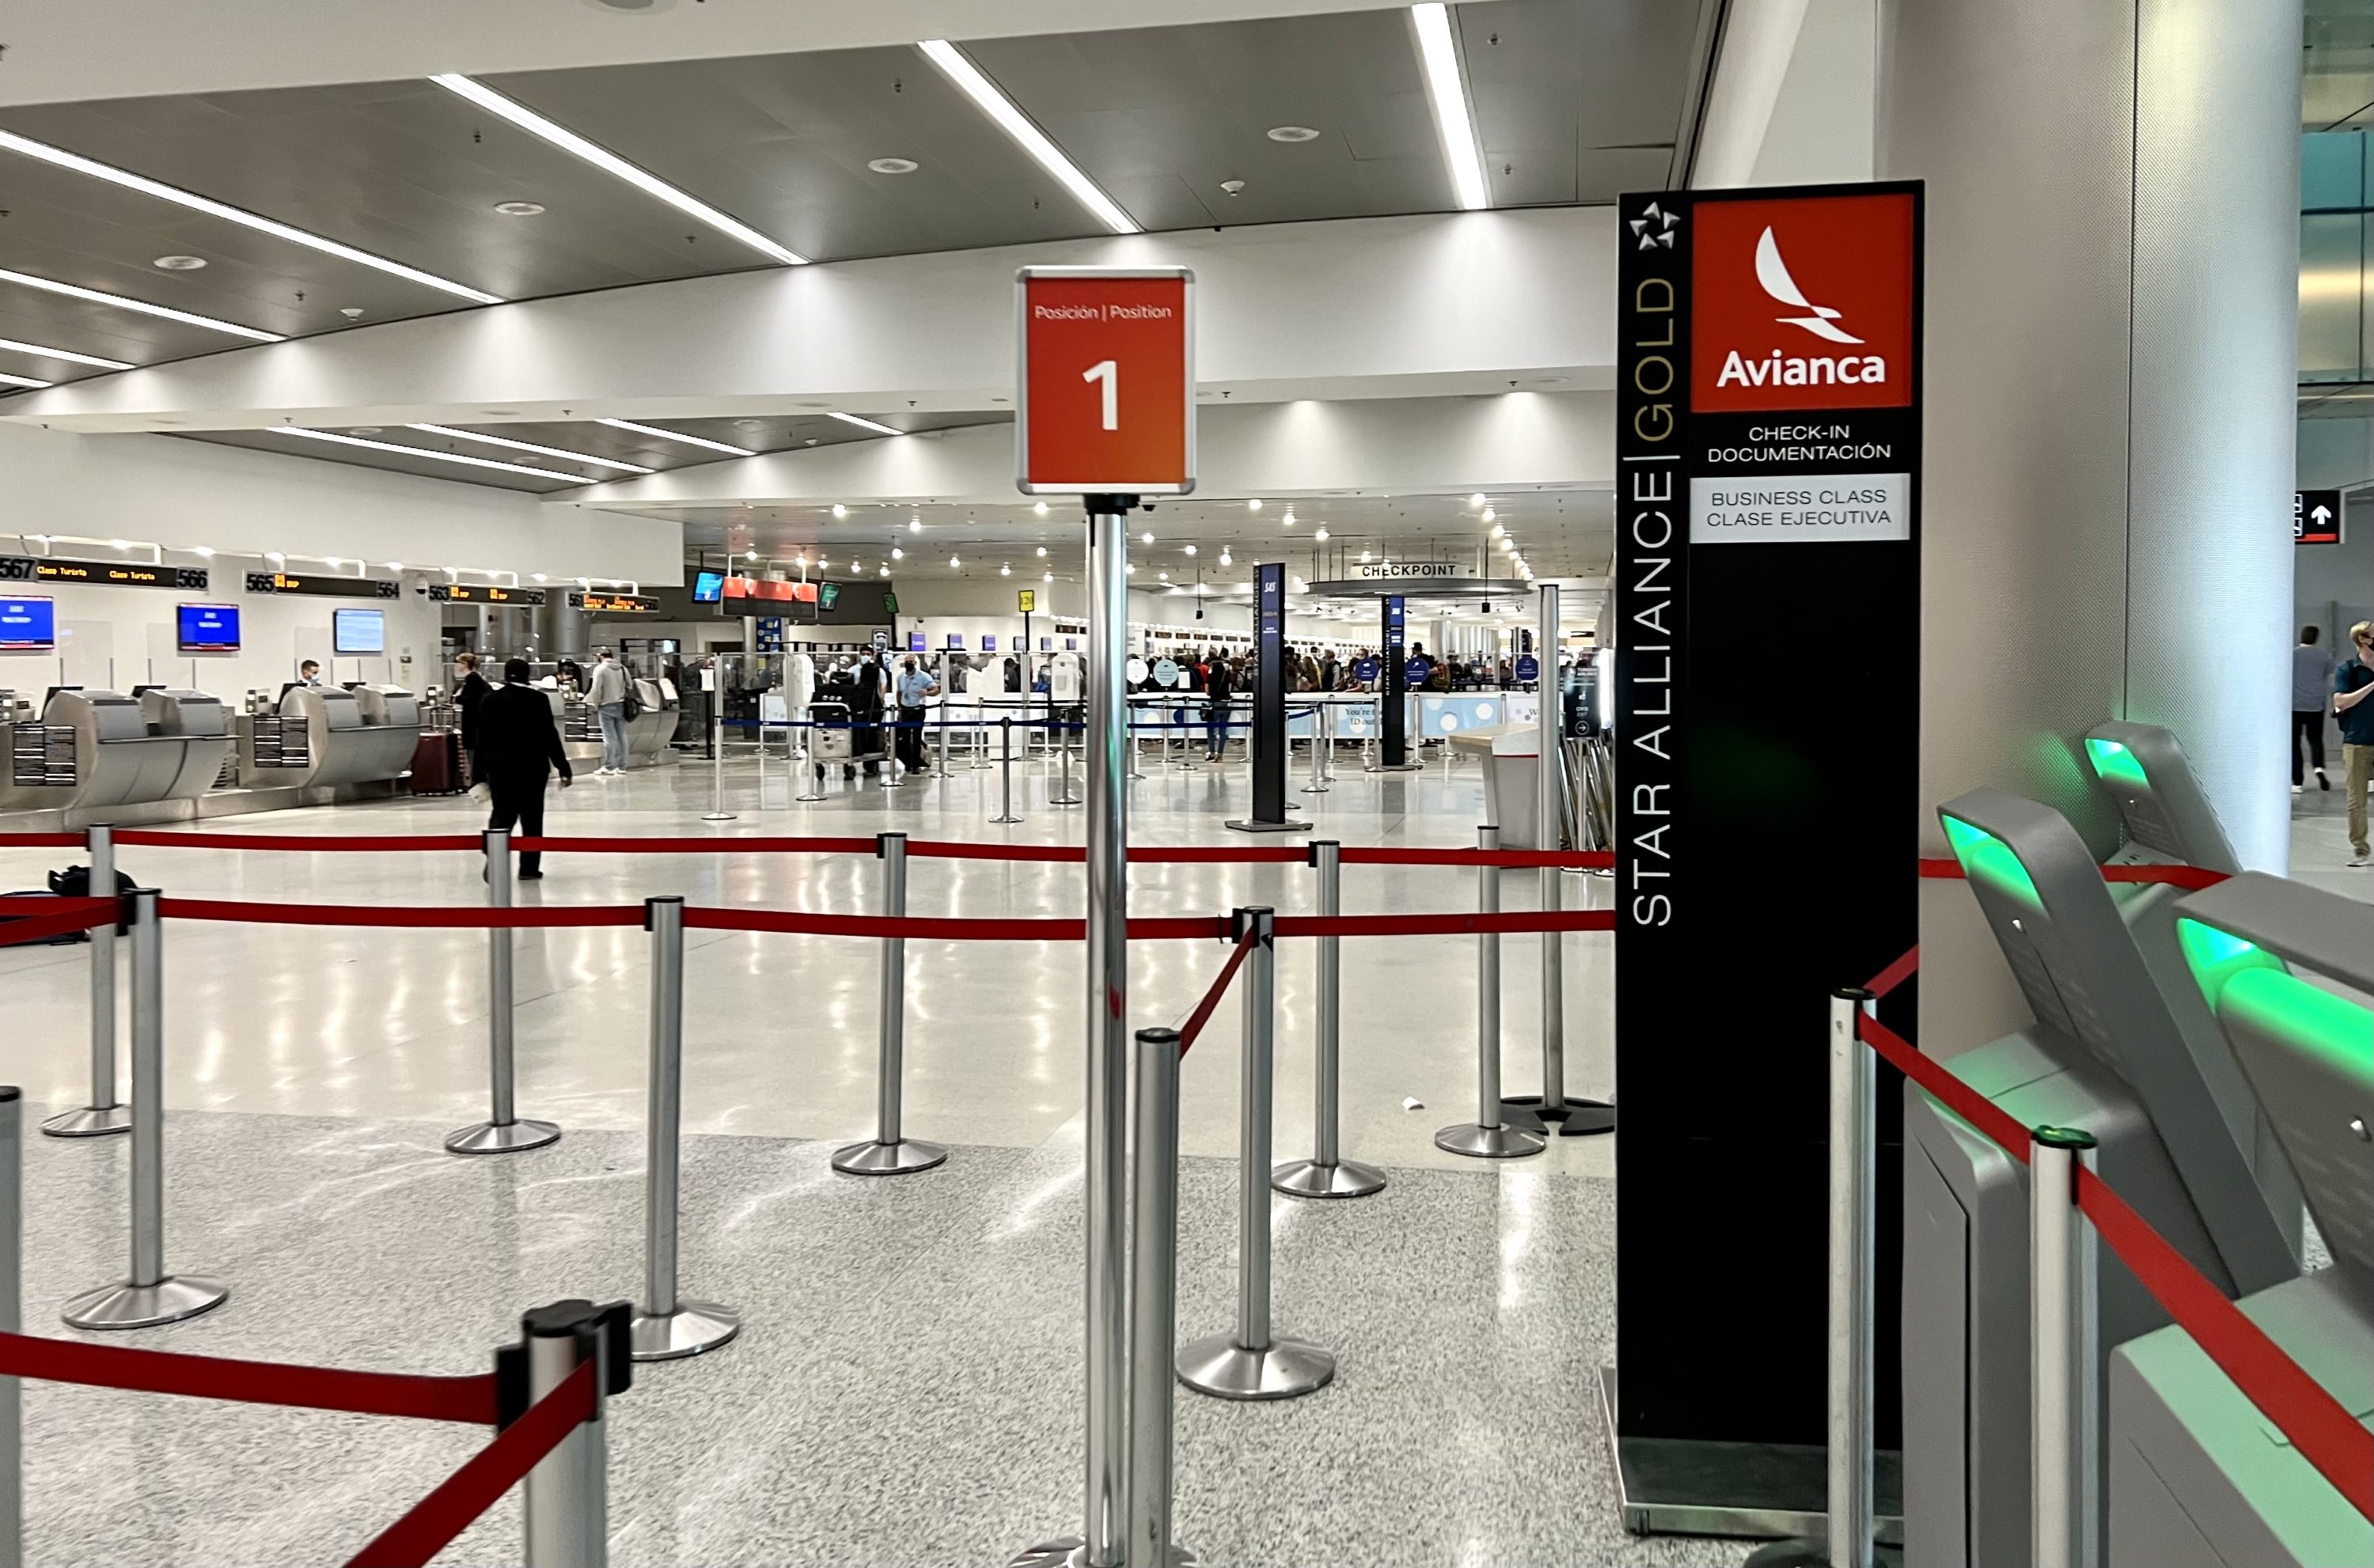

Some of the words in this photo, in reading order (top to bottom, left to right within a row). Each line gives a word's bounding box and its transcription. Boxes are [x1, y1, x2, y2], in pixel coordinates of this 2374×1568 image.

[1034, 305, 1098, 320] Posición
[1109, 304, 1172, 319] Position
[1634, 278, 1674, 442] GOLD
[1716, 349, 1886, 387] Avianca
[1082, 360, 1118, 431] 1
[1749, 425, 1850, 441] CHECK-IN
[1708, 441, 1891, 463] DOCUMENTACIÓN
[1712, 490, 1812, 506] BUSINESS
[1818, 489, 1887, 505] CLASS
[1706, 512, 1773, 527] CLASE
[1780, 510, 1892, 526] EJECUTIVA
[0, 557, 36, 579] 567
[1362, 564, 1455, 577] CHECKPOINT
[176, 569, 208, 589] 566
[246, 574, 274, 592] 565
[377, 582, 400, 598] 564
[429, 585, 450, 601] 563
[528, 592, 545, 604] 562
[1633, 472, 1673, 760] ALLIANCE
[1633, 784, 1671, 926] STAR
